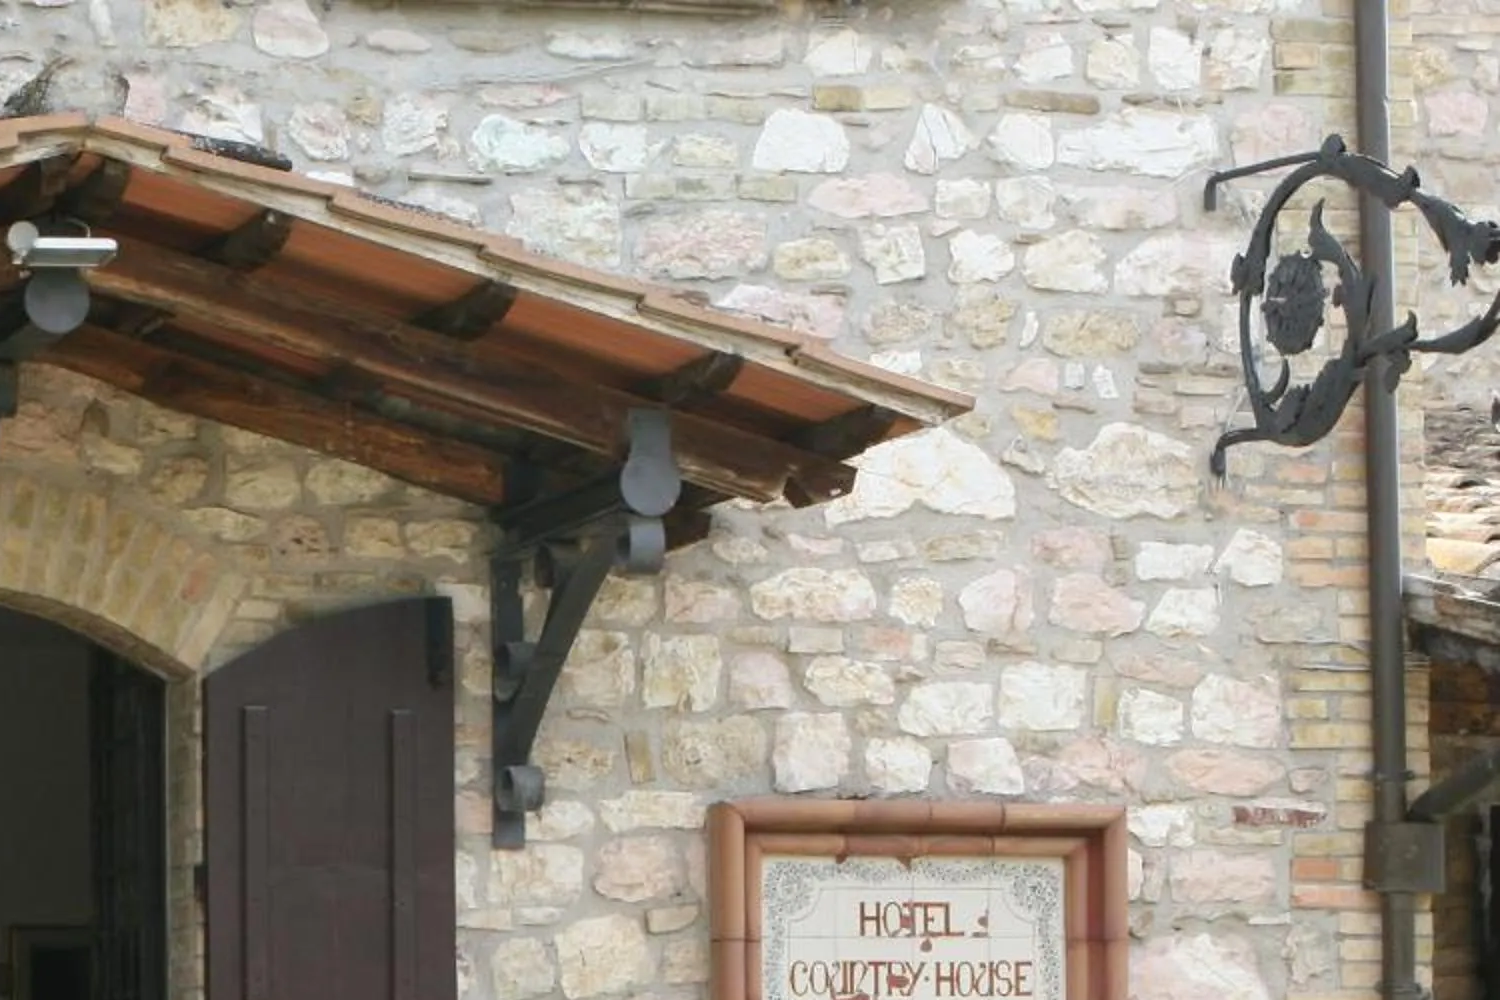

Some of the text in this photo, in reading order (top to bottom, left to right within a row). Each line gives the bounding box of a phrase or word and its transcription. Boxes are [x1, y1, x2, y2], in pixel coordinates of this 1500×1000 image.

[858, 900, 965, 938] HOTEL
[789, 959, 1033, 998] COUNTRY HOUSE
